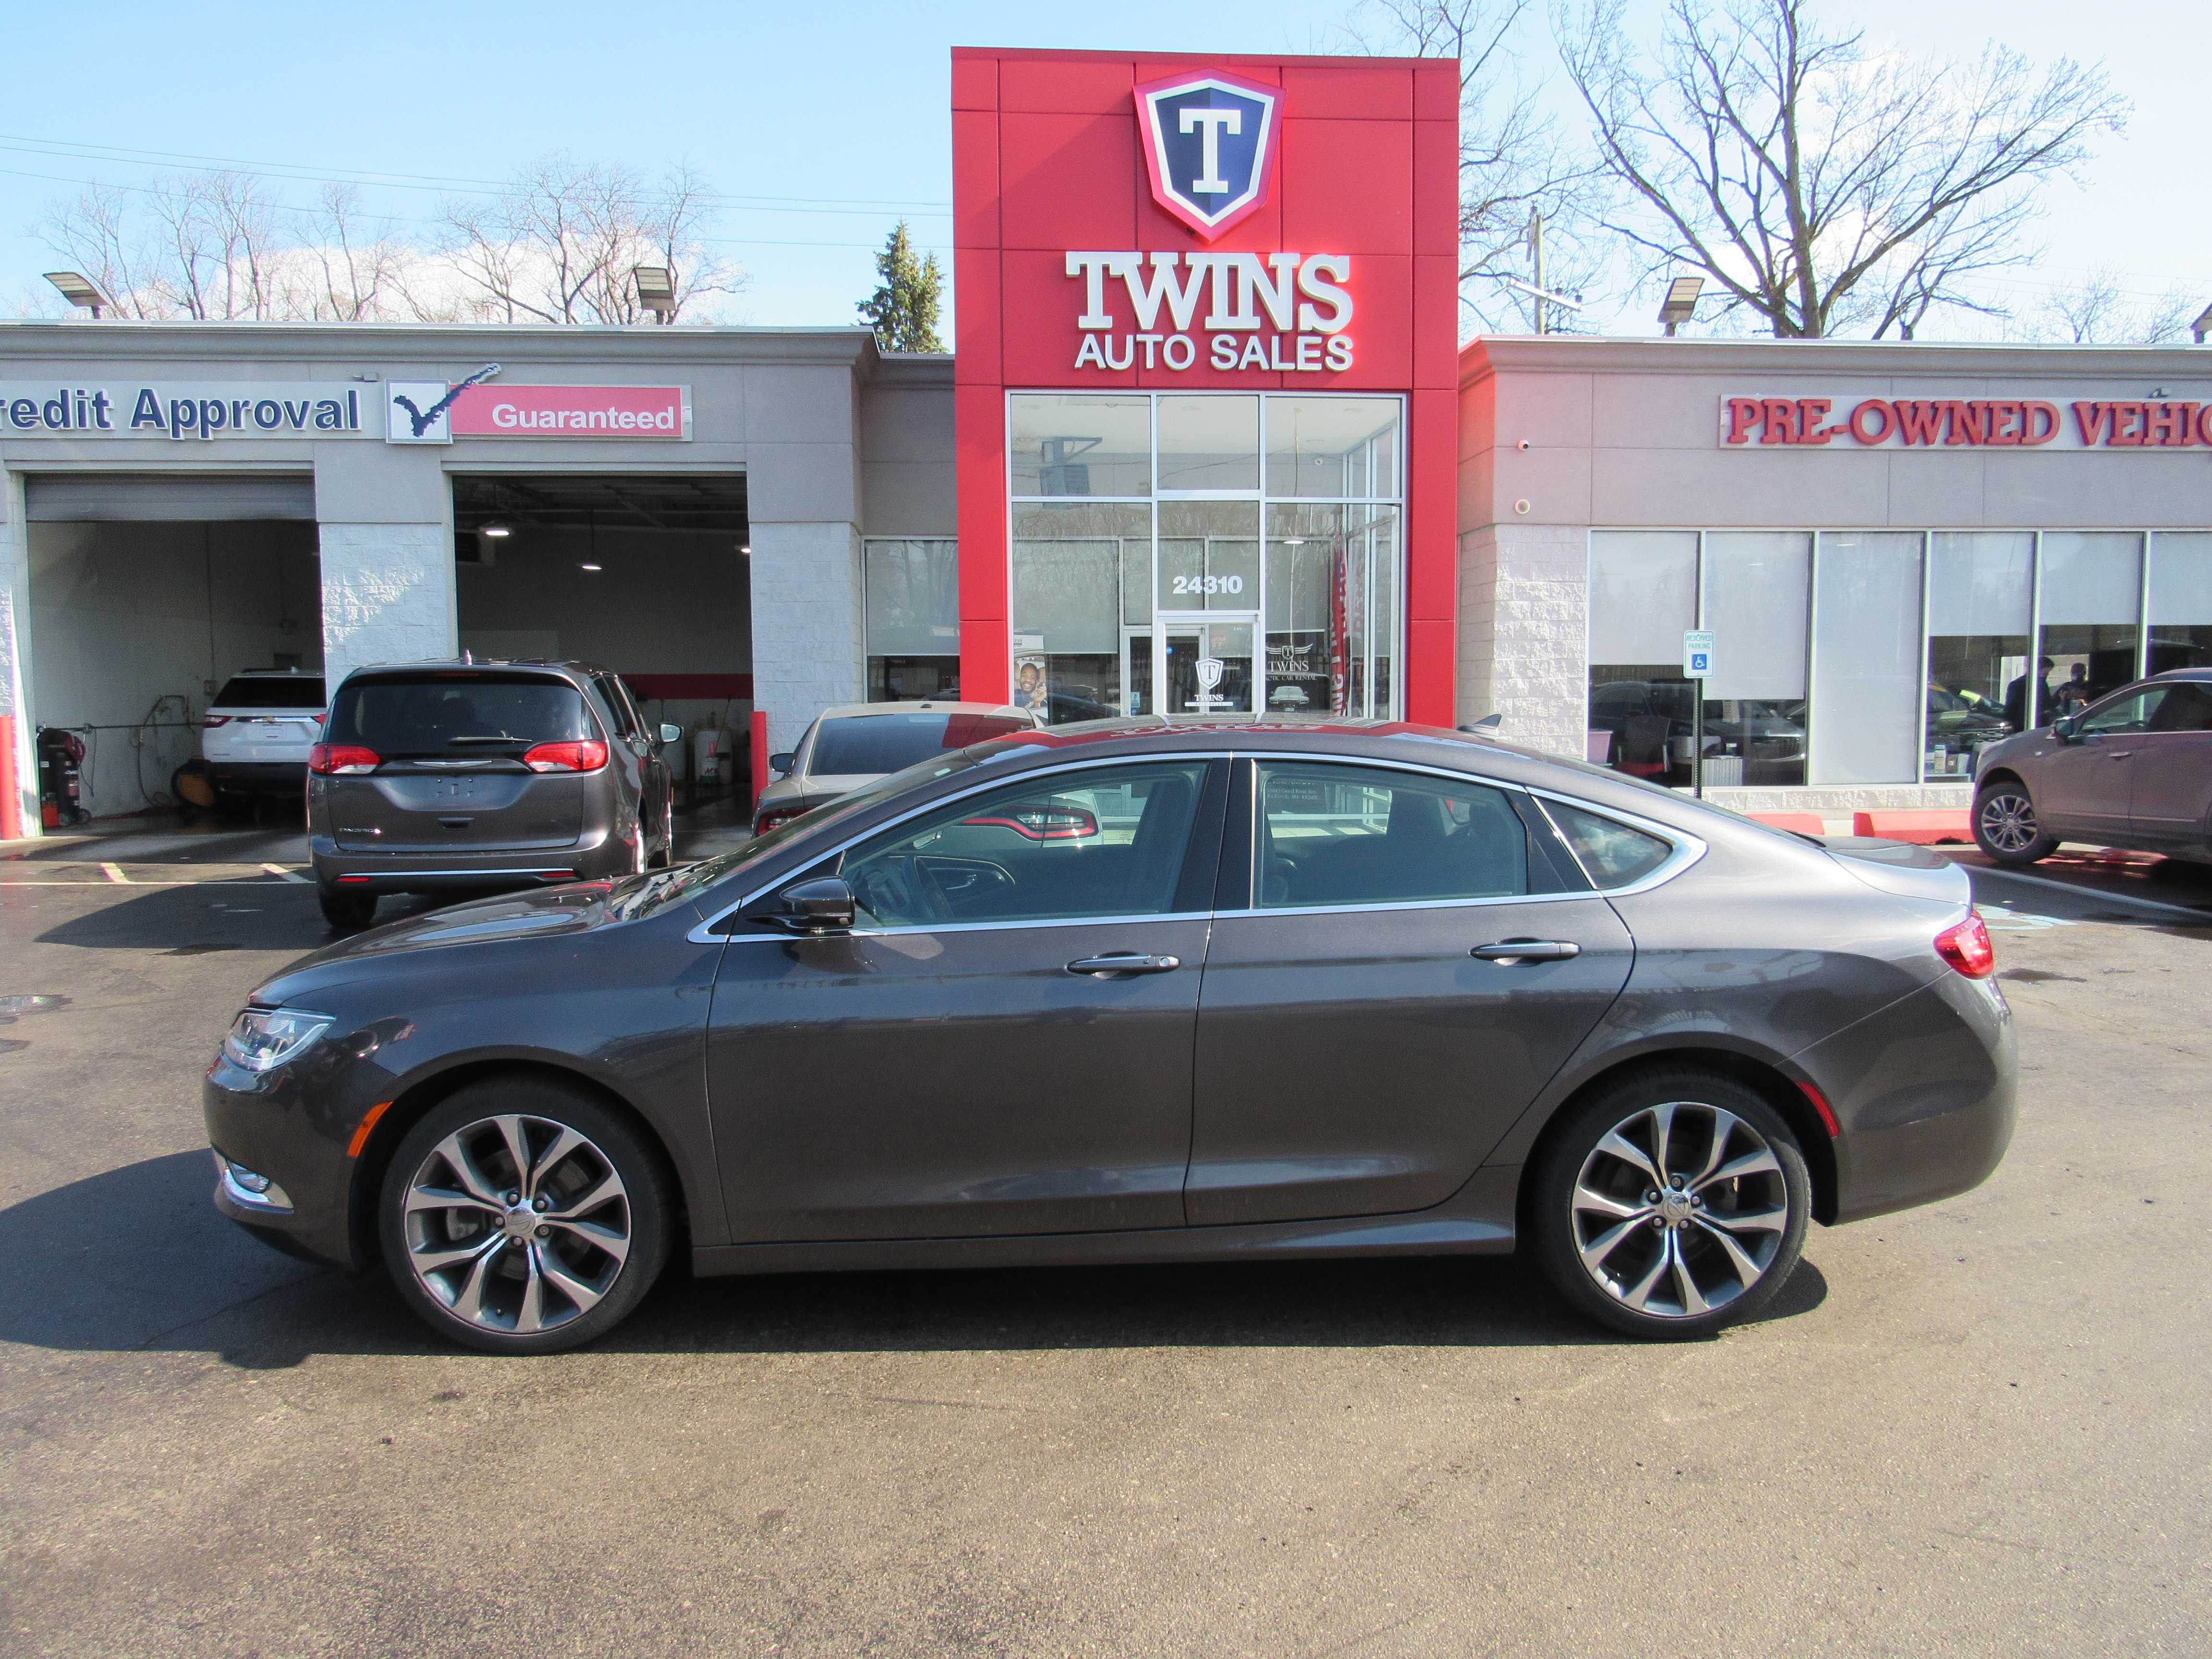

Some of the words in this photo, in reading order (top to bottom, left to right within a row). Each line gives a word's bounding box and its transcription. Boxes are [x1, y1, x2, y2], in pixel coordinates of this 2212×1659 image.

[1179, 108, 1241, 194] T
[1066, 252, 1353, 334] TWINS
[1074, 334, 1196, 371] AUTO
[1210, 335, 1353, 373] SALES
[0, 389, 114, 429] edit
[129, 388, 362, 441] Approval
[492, 404, 674, 430] Guaranteed
[1727, 398, 2061, 445] PRE-OWNED
[1172, 576, 1243, 594] 24310
[1268, 660, 1310, 672] TWINS
